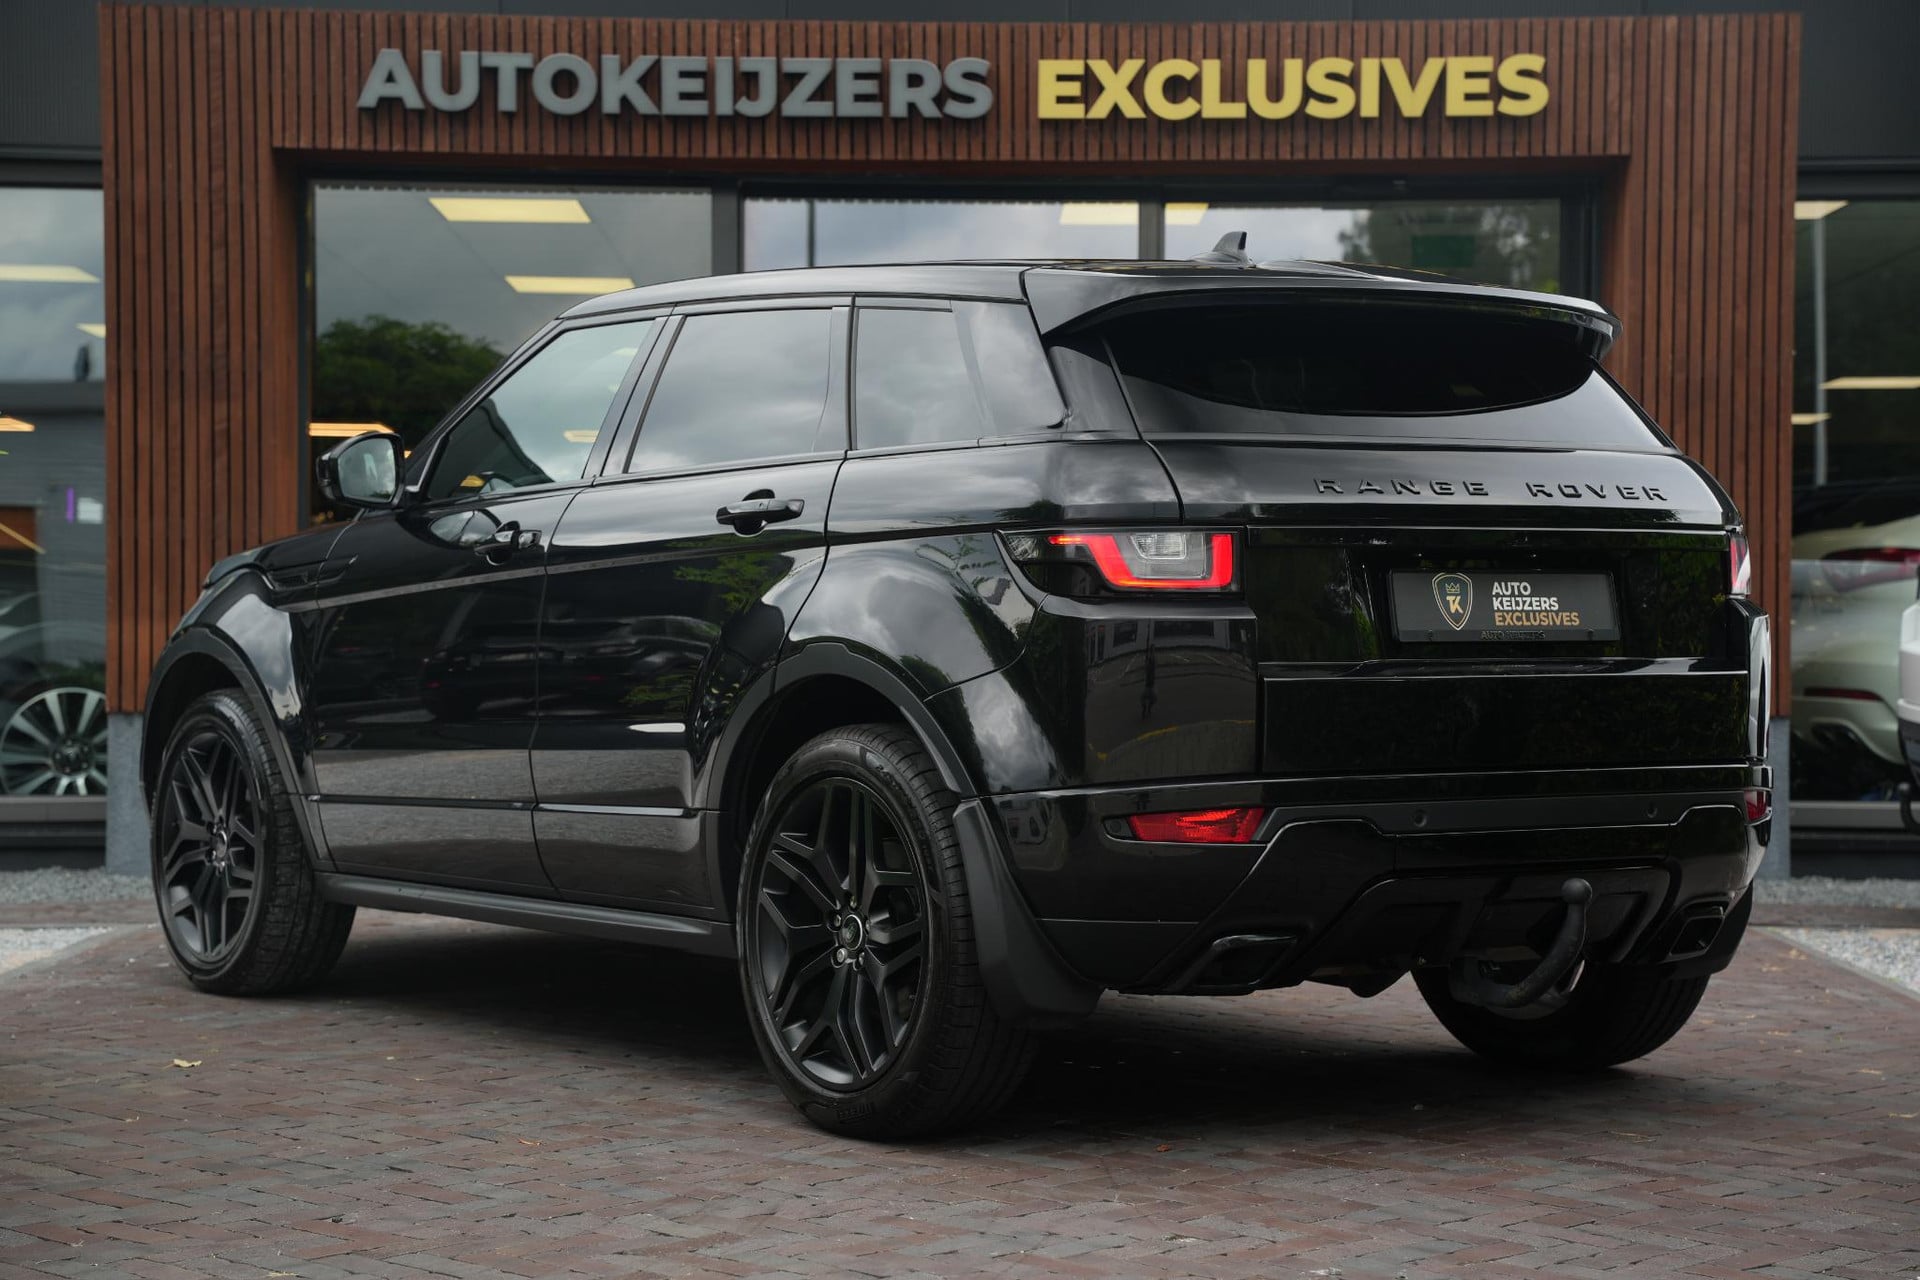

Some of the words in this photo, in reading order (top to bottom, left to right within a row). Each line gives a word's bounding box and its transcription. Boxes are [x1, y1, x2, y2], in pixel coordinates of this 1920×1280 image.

[357, 48, 993, 118] AUTOKEIJZERS
[1038, 53, 1550, 120] EXCLUSIVES
[1314, 478, 1489, 495] RANGE
[1526, 482, 1667, 500] ROVER
[1492, 581, 1531, 595] AUTO
[1492, 597, 1559, 610] KEIJZERS
[1495, 611, 1580, 626] EXCLUSIVES
